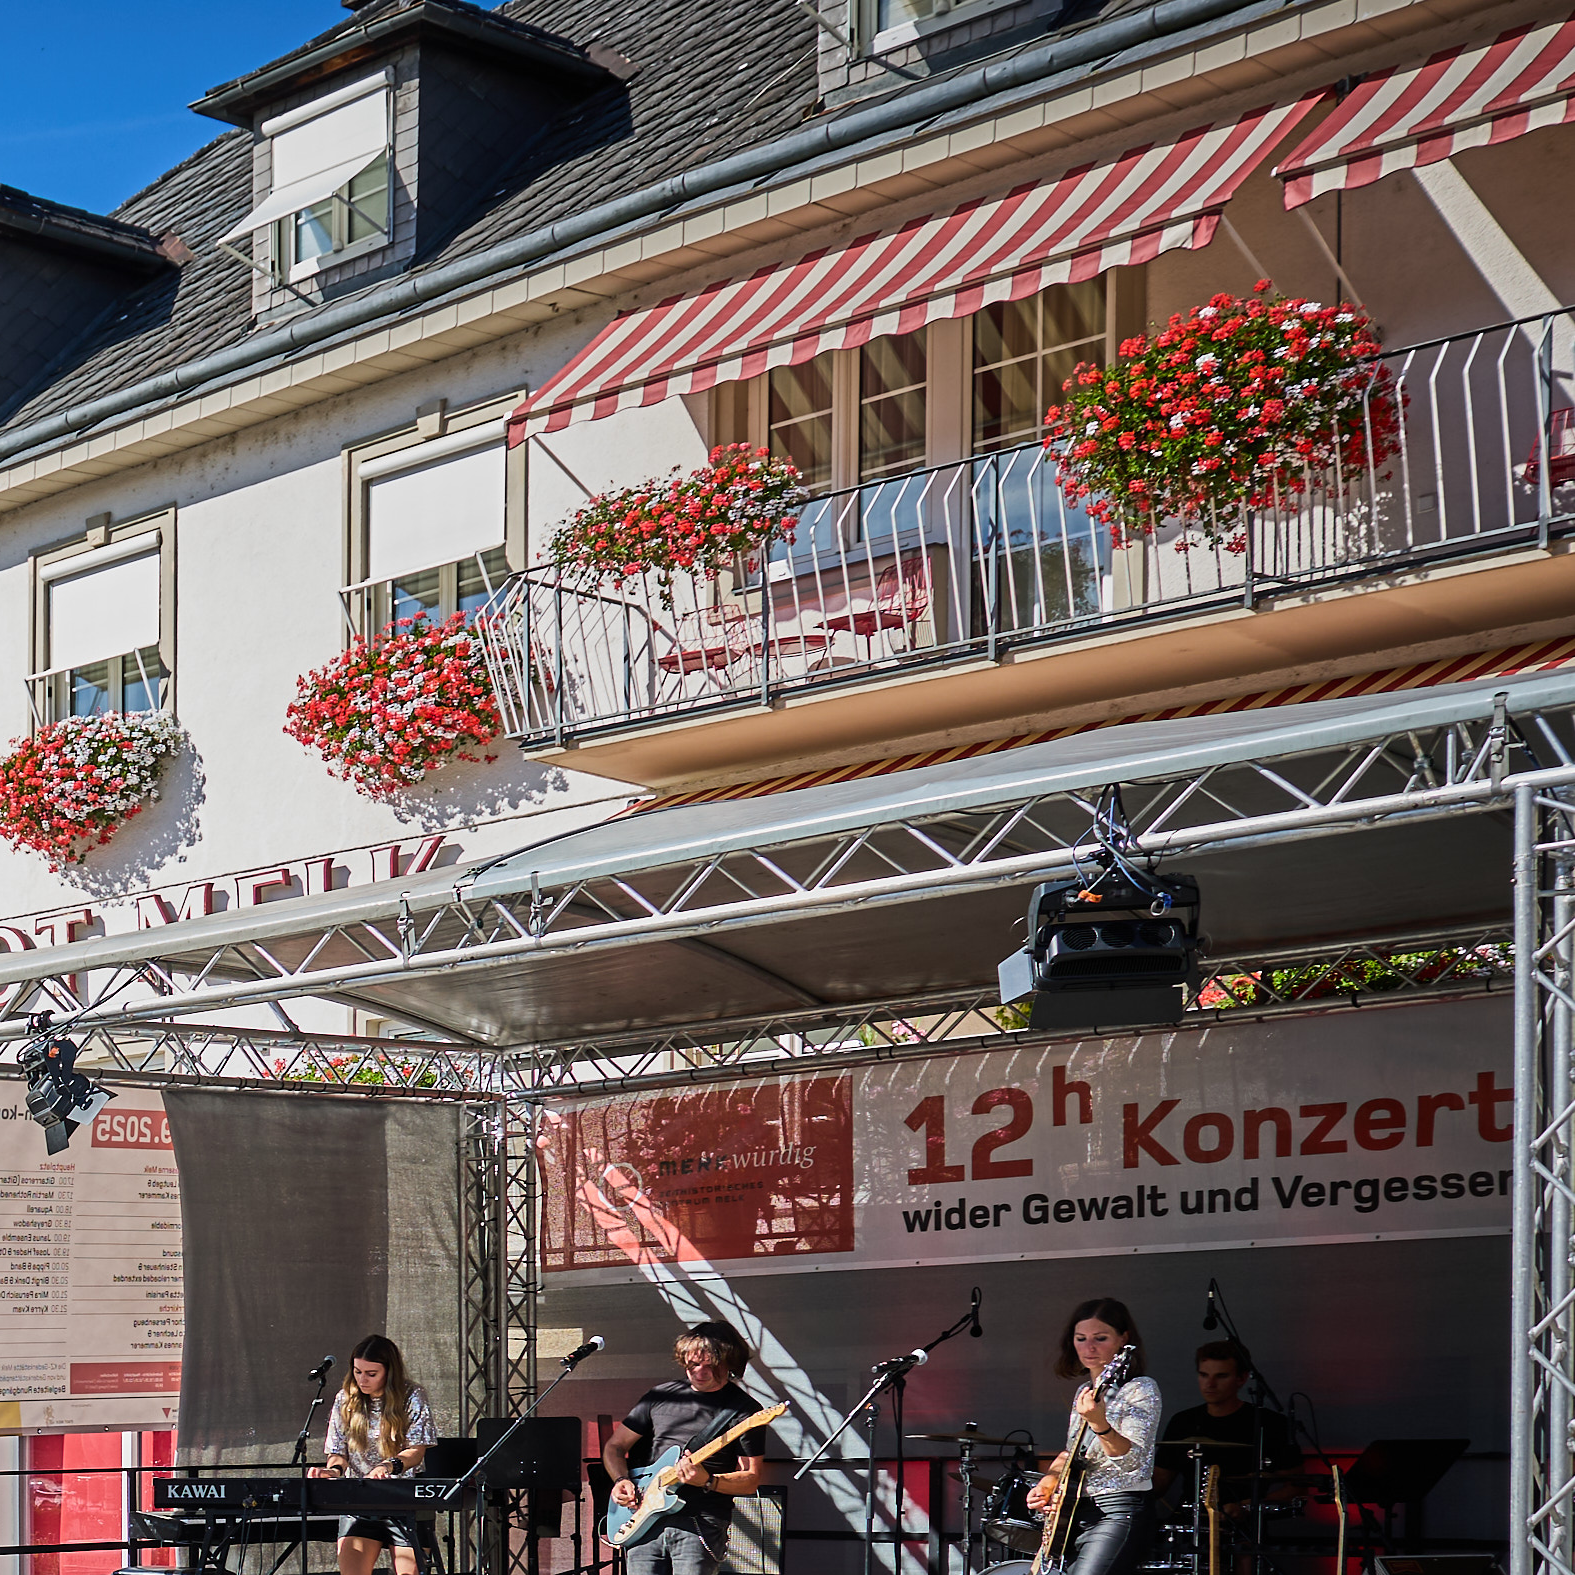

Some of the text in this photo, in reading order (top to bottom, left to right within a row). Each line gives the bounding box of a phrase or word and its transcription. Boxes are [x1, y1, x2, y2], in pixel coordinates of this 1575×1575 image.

[1123, 1071, 1514, 1170] Konzert
[902, 1198, 1011, 1232] wider
[1023, 1184, 1169, 1224] Gewalt
[1180, 1178, 1259, 1214] und
[167, 1484, 447, 1498] KAWAI ES7
